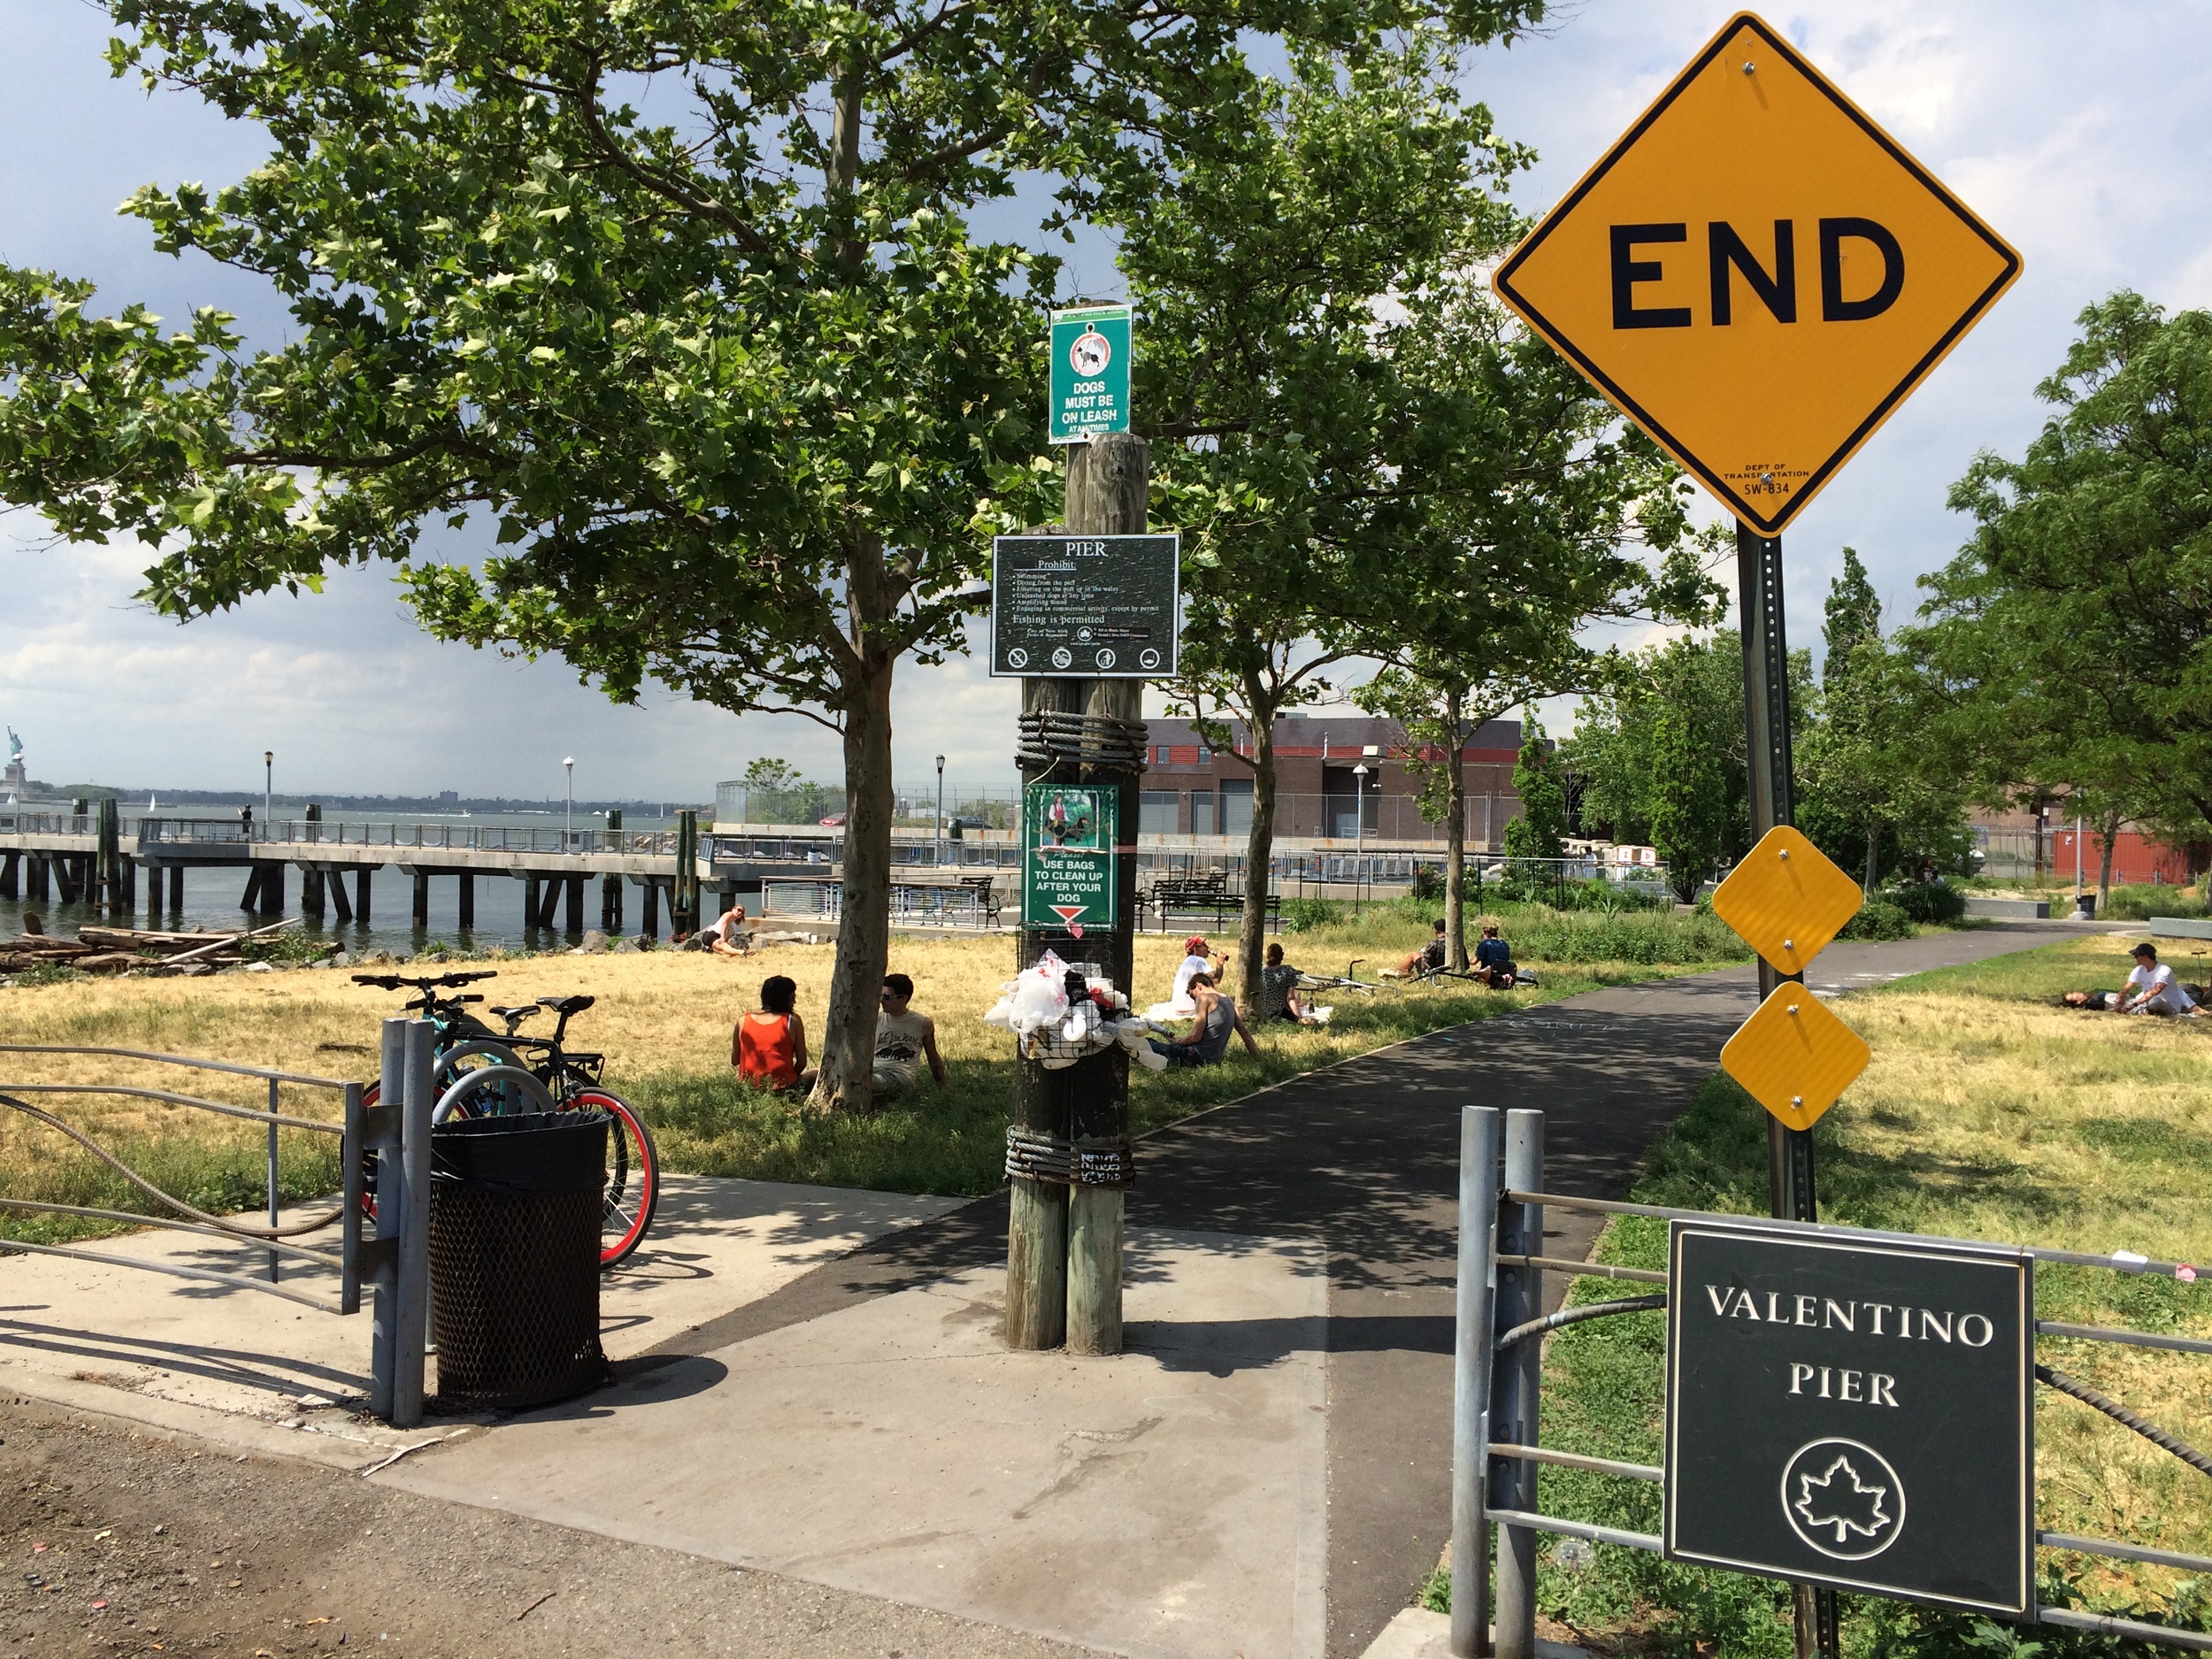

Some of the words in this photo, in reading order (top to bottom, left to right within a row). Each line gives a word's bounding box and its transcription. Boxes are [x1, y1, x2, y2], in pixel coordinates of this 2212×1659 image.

[1609, 217, 1905, 330] END
[1074, 381, 1105, 394] DOGS
[1065, 396, 1096, 409] MUST
[1098, 395, 1113, 407] BE
[1062, 412, 1078, 425] ON
[1080, 410, 1117, 423] LEASH
[1089, 423, 1110, 432] TIMES
[1724, 471, 1809, 480] TRANSPRTATION
[1745, 483, 1789, 495] SW-834
[1065, 541, 1108, 557] PIER
[1038, 560, 1077, 569] Prohibit:
[1012, 615, 1046, 625] Fishing
[1050, 615, 1058, 624] is
[1061, 615, 1105, 625] permitted
[1043, 860, 1064, 870] USE
[1067, 861, 1095, 870] BAGS
[1034, 871, 1048, 879] TO
[1052, 872, 1086, 880] CLEAN
[1089, 872, 1103, 881] UP
[1036, 882, 1070, 891] AFTER
[1072, 883, 1101, 892] YOUR
[1057, 894, 1080, 902] DOG
[1703, 1283, 1994, 1348] VALENTINO
[1787, 1362, 1900, 1408] PIER
